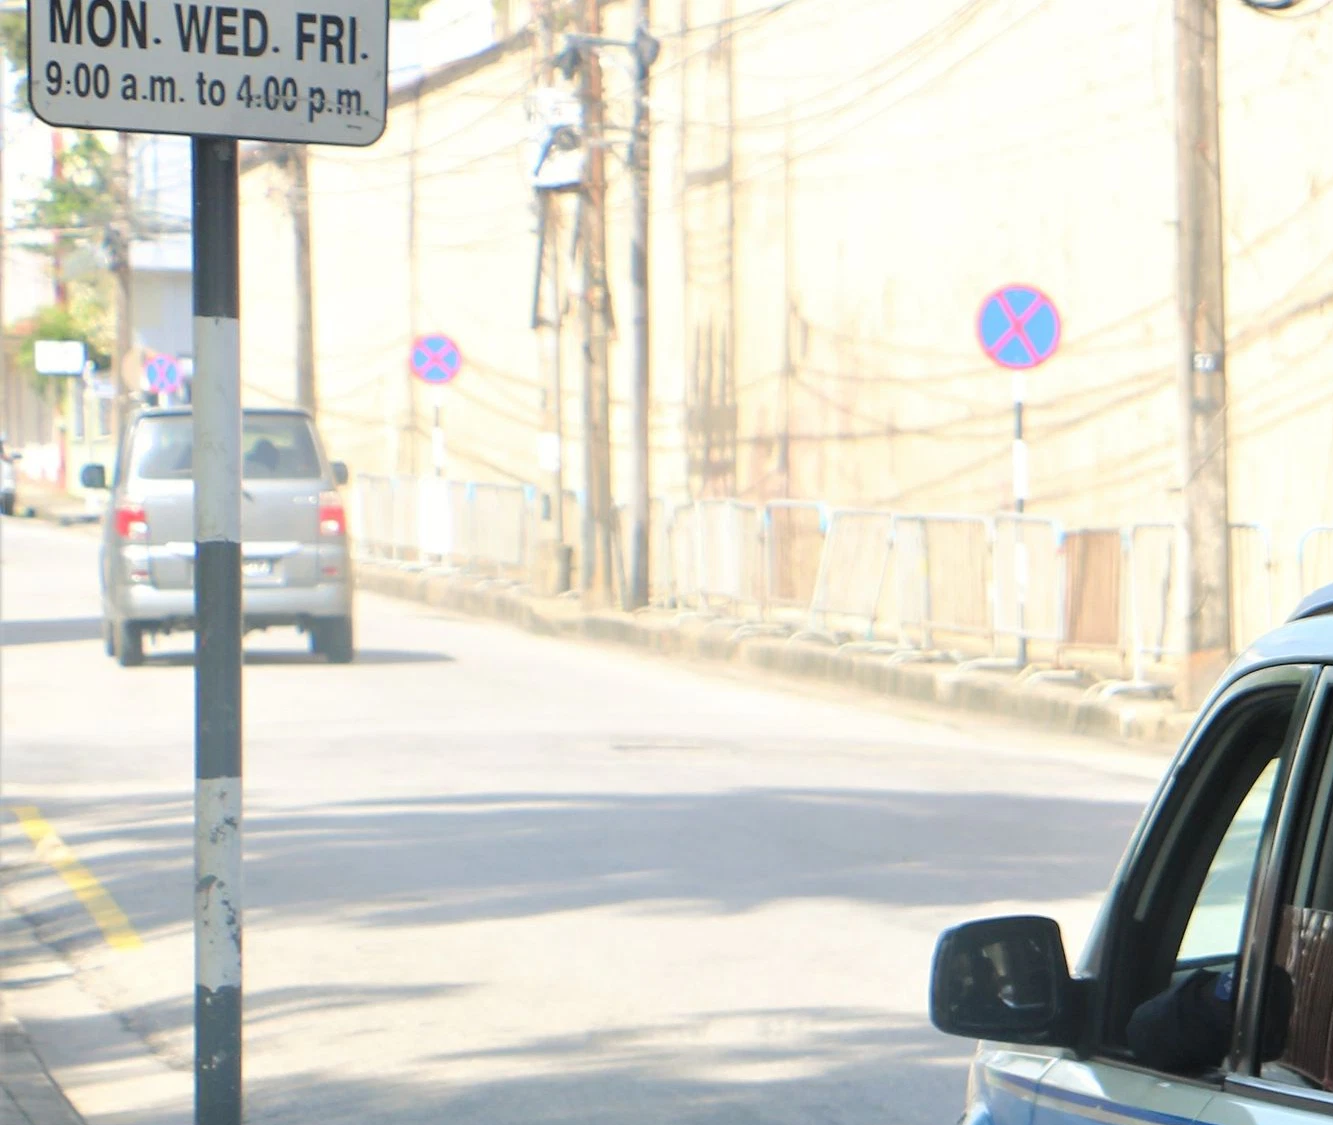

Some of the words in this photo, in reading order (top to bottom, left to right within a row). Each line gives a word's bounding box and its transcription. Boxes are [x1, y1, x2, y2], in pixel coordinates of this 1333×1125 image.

[49, 0, 162, 49] MON.
[174, 3, 280, 57] WED.
[296, 12, 369, 64] FRI.
[45, 60, 110, 99] 9:00
[121, 73, 185, 103] a.m.
[196, 71, 225, 107] to
[237, 74, 298, 112] 4:00
[308, 86, 370, 123] p.m.
